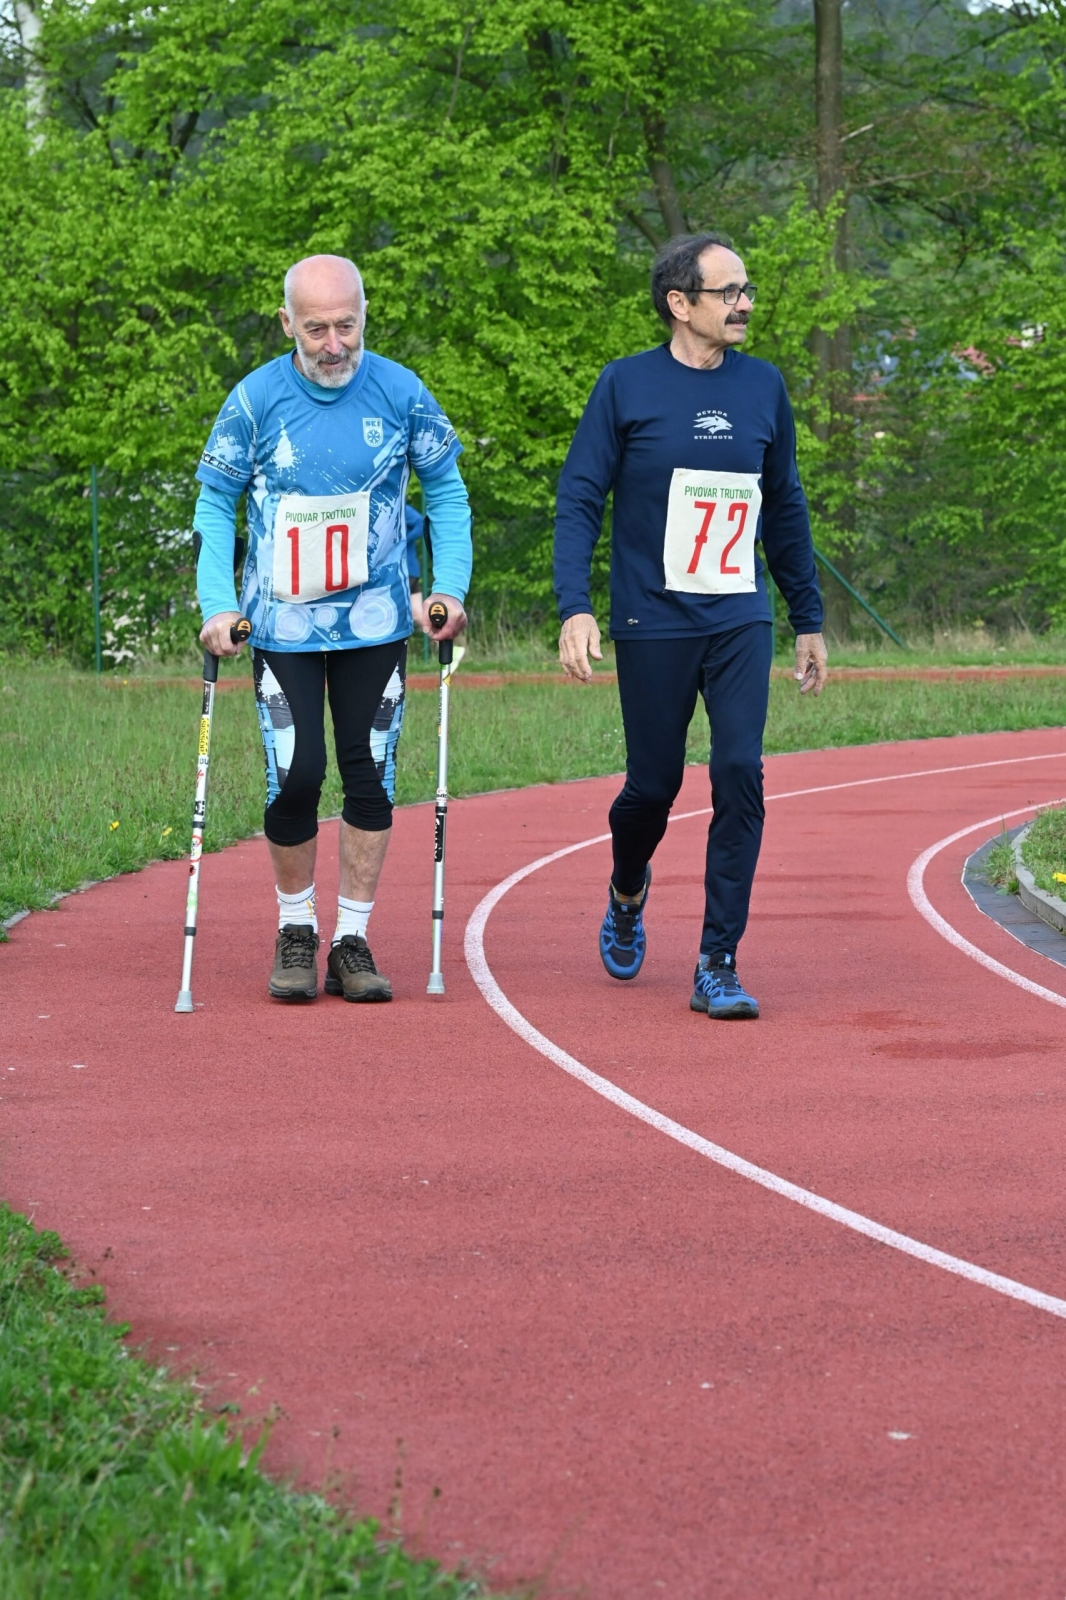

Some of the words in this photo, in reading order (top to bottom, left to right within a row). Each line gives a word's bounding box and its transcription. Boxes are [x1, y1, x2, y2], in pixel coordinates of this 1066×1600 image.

[696, 409, 728, 417] NEVADA
[685, 485, 718, 498] PIVOVAR
[720, 487, 754, 500] TRUTNOV
[285, 511, 319, 523] PIVOVAR
[321, 507, 357, 522] TRUTNOV
[686, 501, 749, 574] 72
